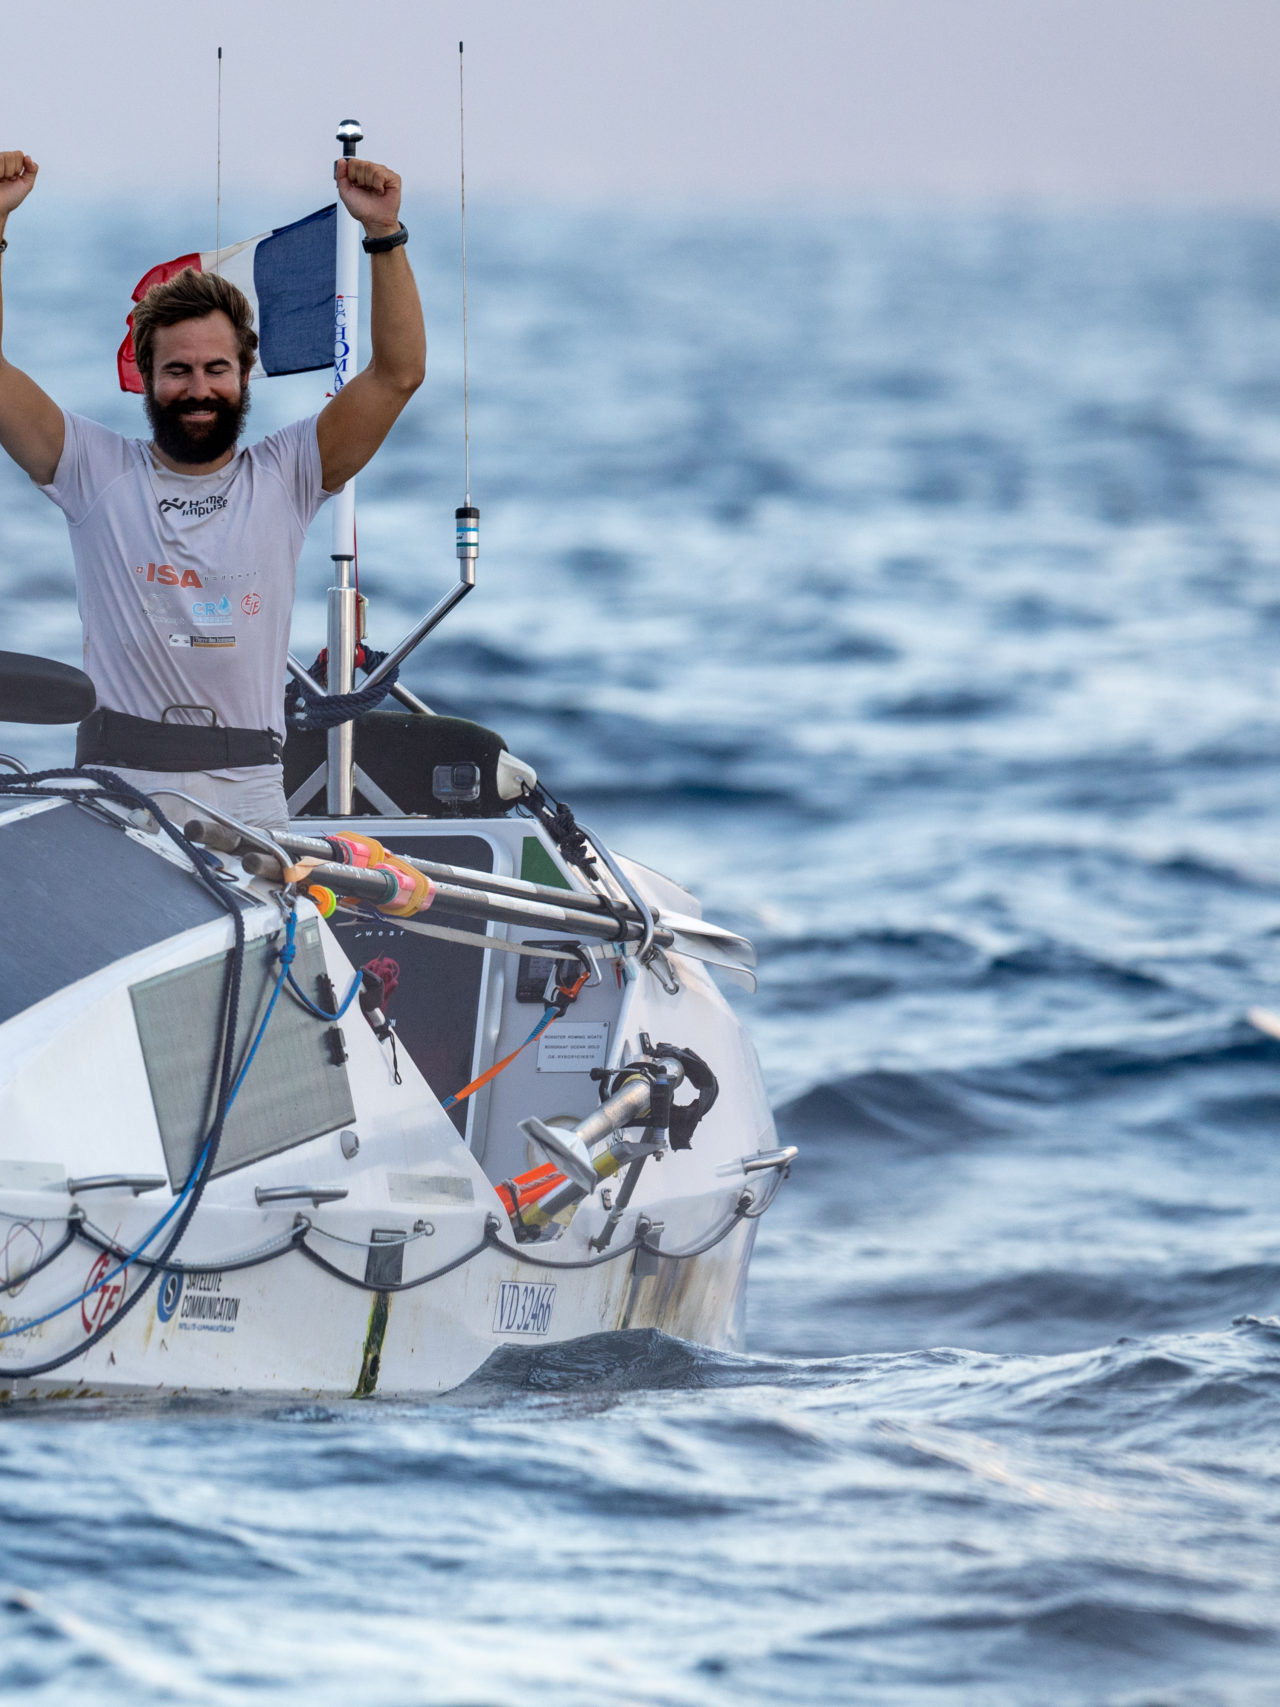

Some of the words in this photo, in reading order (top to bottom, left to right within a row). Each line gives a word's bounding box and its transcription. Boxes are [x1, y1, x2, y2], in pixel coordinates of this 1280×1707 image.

[146, 562, 204, 589] ISA
[185, 1272, 223, 1292] SATELLITE
[180, 1294, 241, 1321] COMMUNICATION
[500, 1284, 520, 1331] VD
[516, 1286, 556, 1332] 32466
